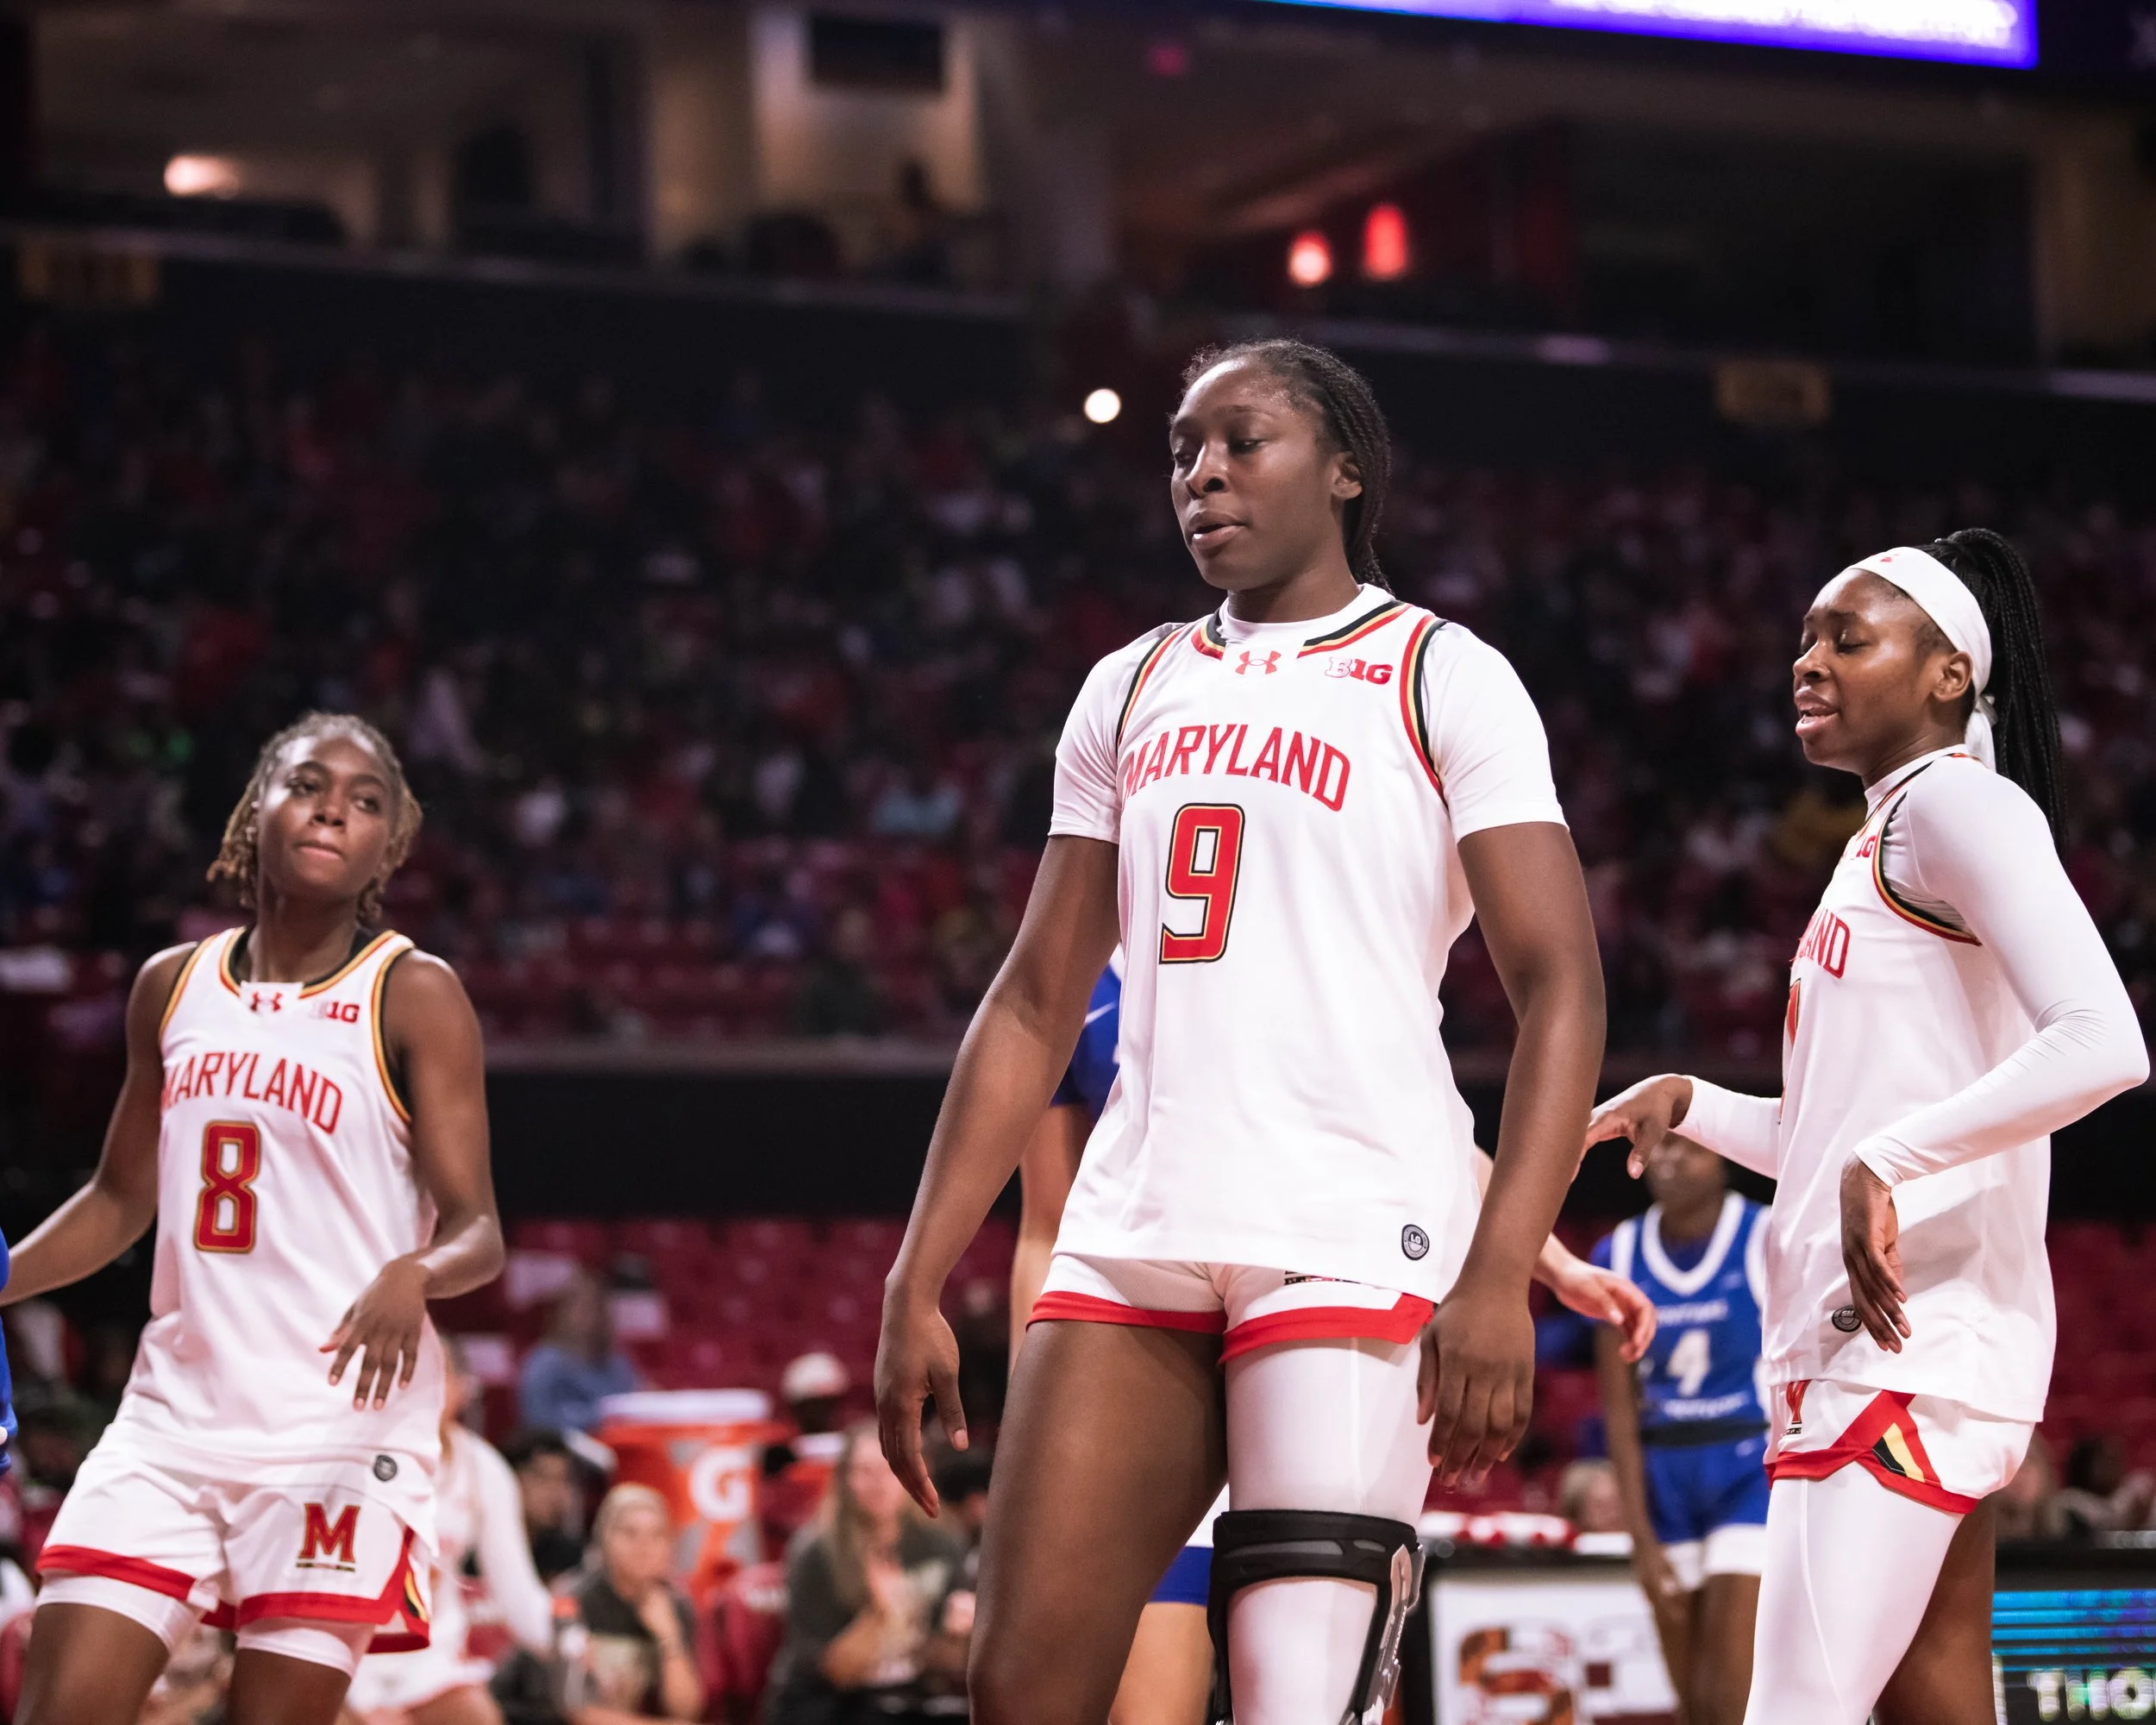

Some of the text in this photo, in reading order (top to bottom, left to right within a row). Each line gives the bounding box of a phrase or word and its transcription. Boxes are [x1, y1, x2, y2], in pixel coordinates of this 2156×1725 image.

[1121, 724, 1351, 812] MARYLAND
[1158, 802, 1245, 964] 9
[161, 1052, 343, 1136] MARYLAND
[193, 1120, 262, 1255] 8
[1665, 1327, 1711, 1397] 4
[691, 1446, 751, 1521] G
[298, 1502, 361, 1564] M
[2027, 1666, 2156, 1722] THO
